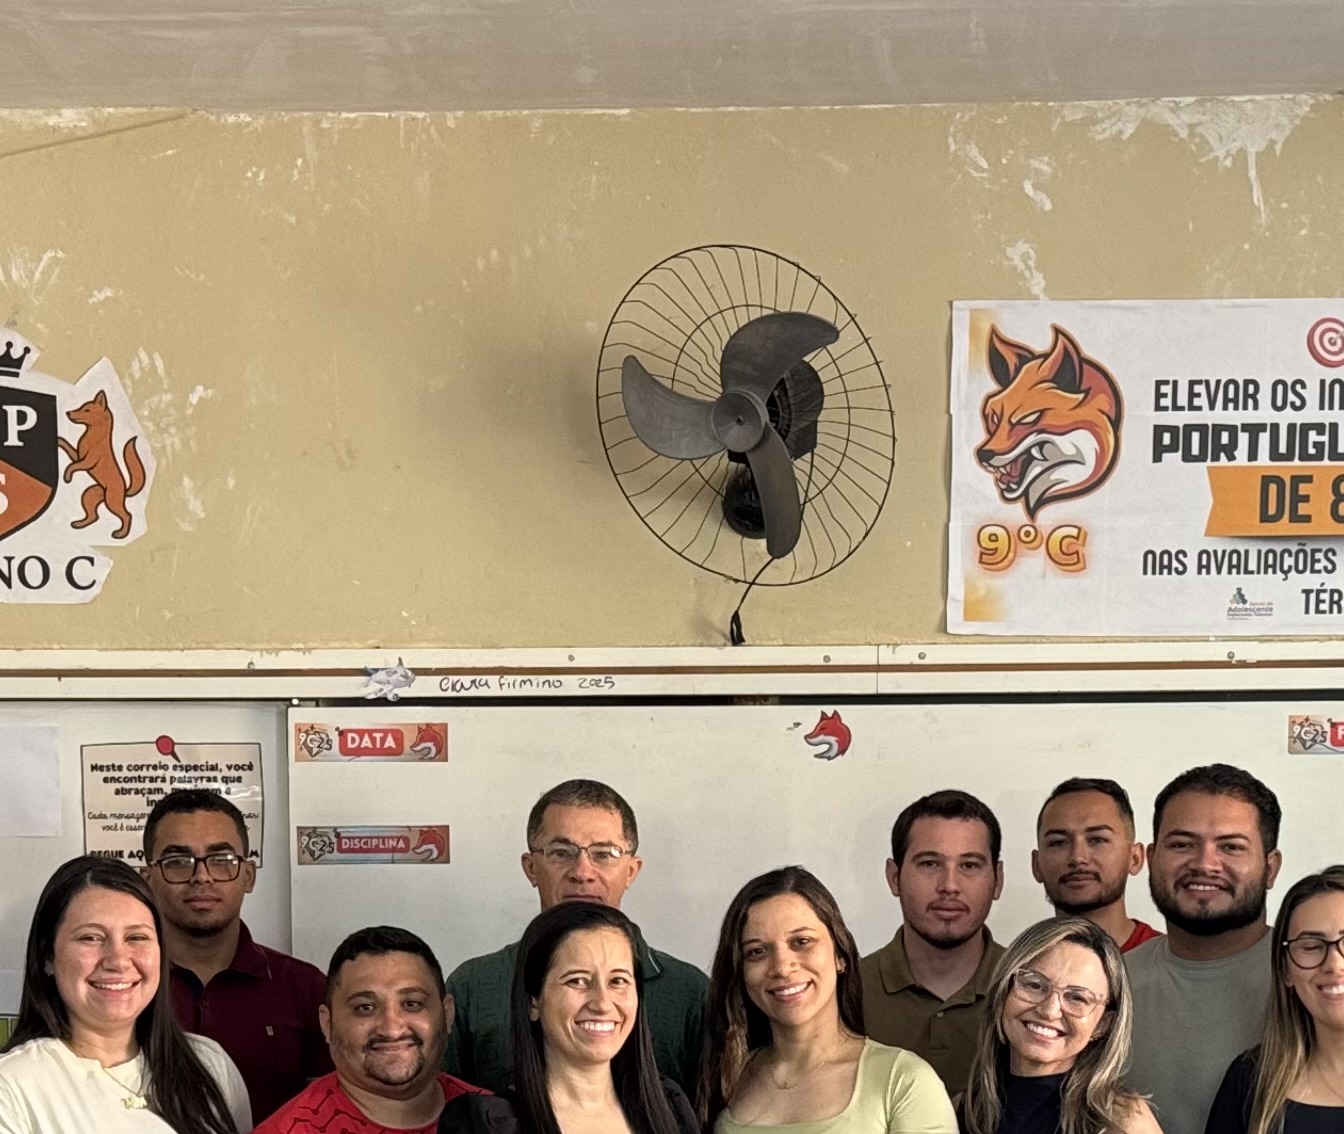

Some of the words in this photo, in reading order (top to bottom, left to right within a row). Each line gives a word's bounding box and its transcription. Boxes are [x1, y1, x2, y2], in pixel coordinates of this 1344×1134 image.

[1154, 379, 1260, 412] ELEVAR
[1271, 379, 1307, 411] OS
[2, 405, 38, 446] P
[1259, 474, 1314, 523] DE
[64, 556, 97, 590] C
[1143, 549, 1188, 576] NAS
[1197, 542, 1337, 581] AVALIAÇÕES
[347, 732, 397, 749] DATA
[90, 763, 123, 773] Neste
[126, 761, 170, 773] correio
[172, 761, 222, 774] especial,
[226, 761, 254, 772] você
[102, 773, 167, 784] encontrará
[221, 775, 243, 787] que
[128, 850, 144, 859] AQ
[341, 837, 406, 849] DISCIPLINA
